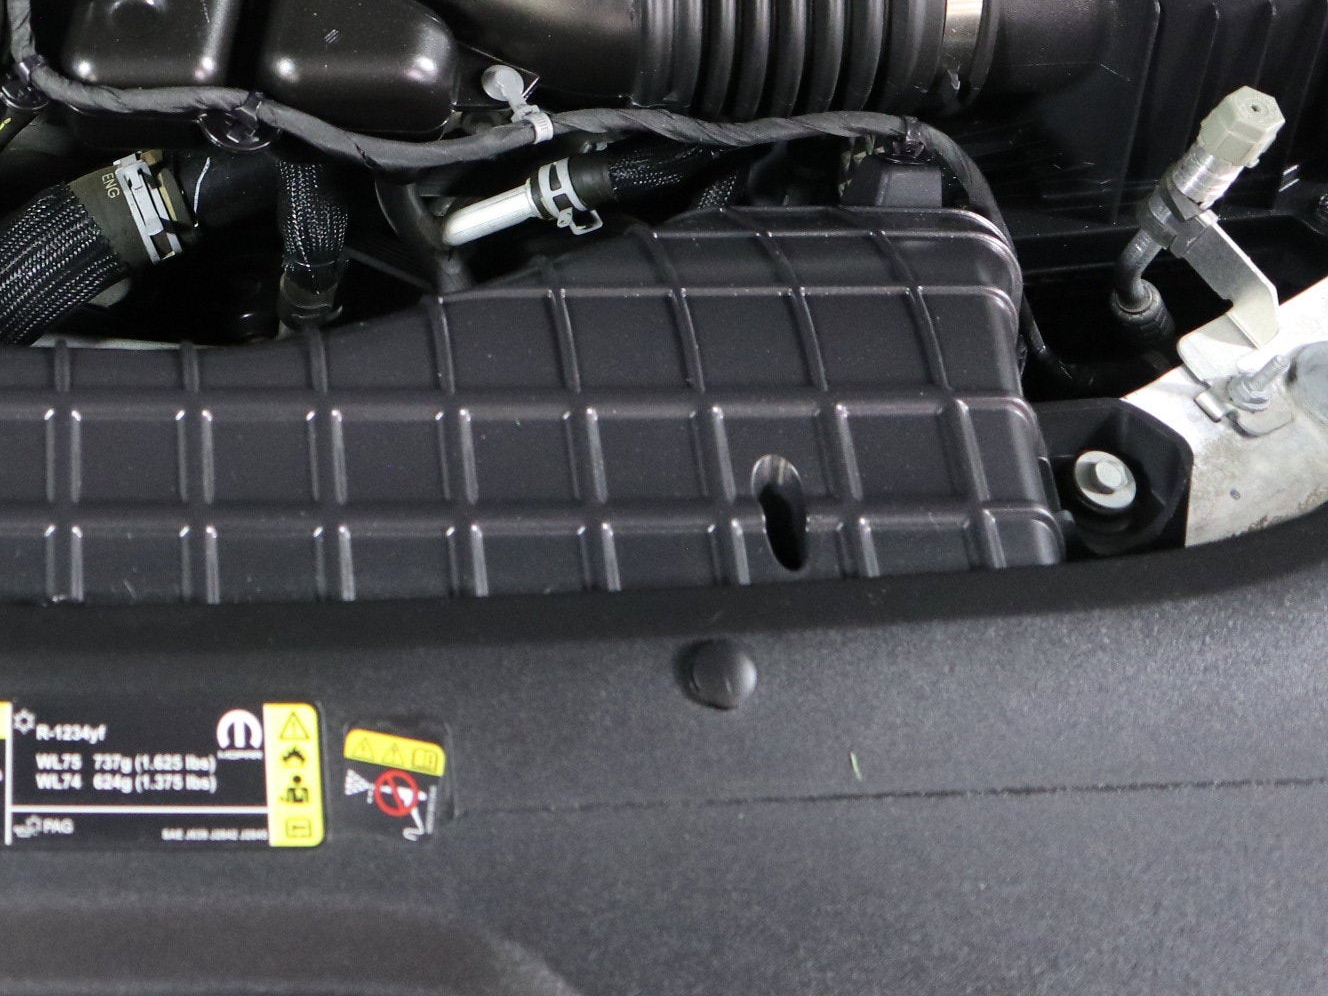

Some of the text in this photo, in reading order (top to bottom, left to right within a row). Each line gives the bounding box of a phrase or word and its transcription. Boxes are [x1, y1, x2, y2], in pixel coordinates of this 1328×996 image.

[102, 172, 120, 199] ENG
[36, 724, 107, 744] R-1234yf
[36, 753, 216, 775] WL75 737g (1.625 lbs)
[36, 773, 216, 794] WL74 624g (1.375 lbs)
[42, 817, 74, 834] PAG
